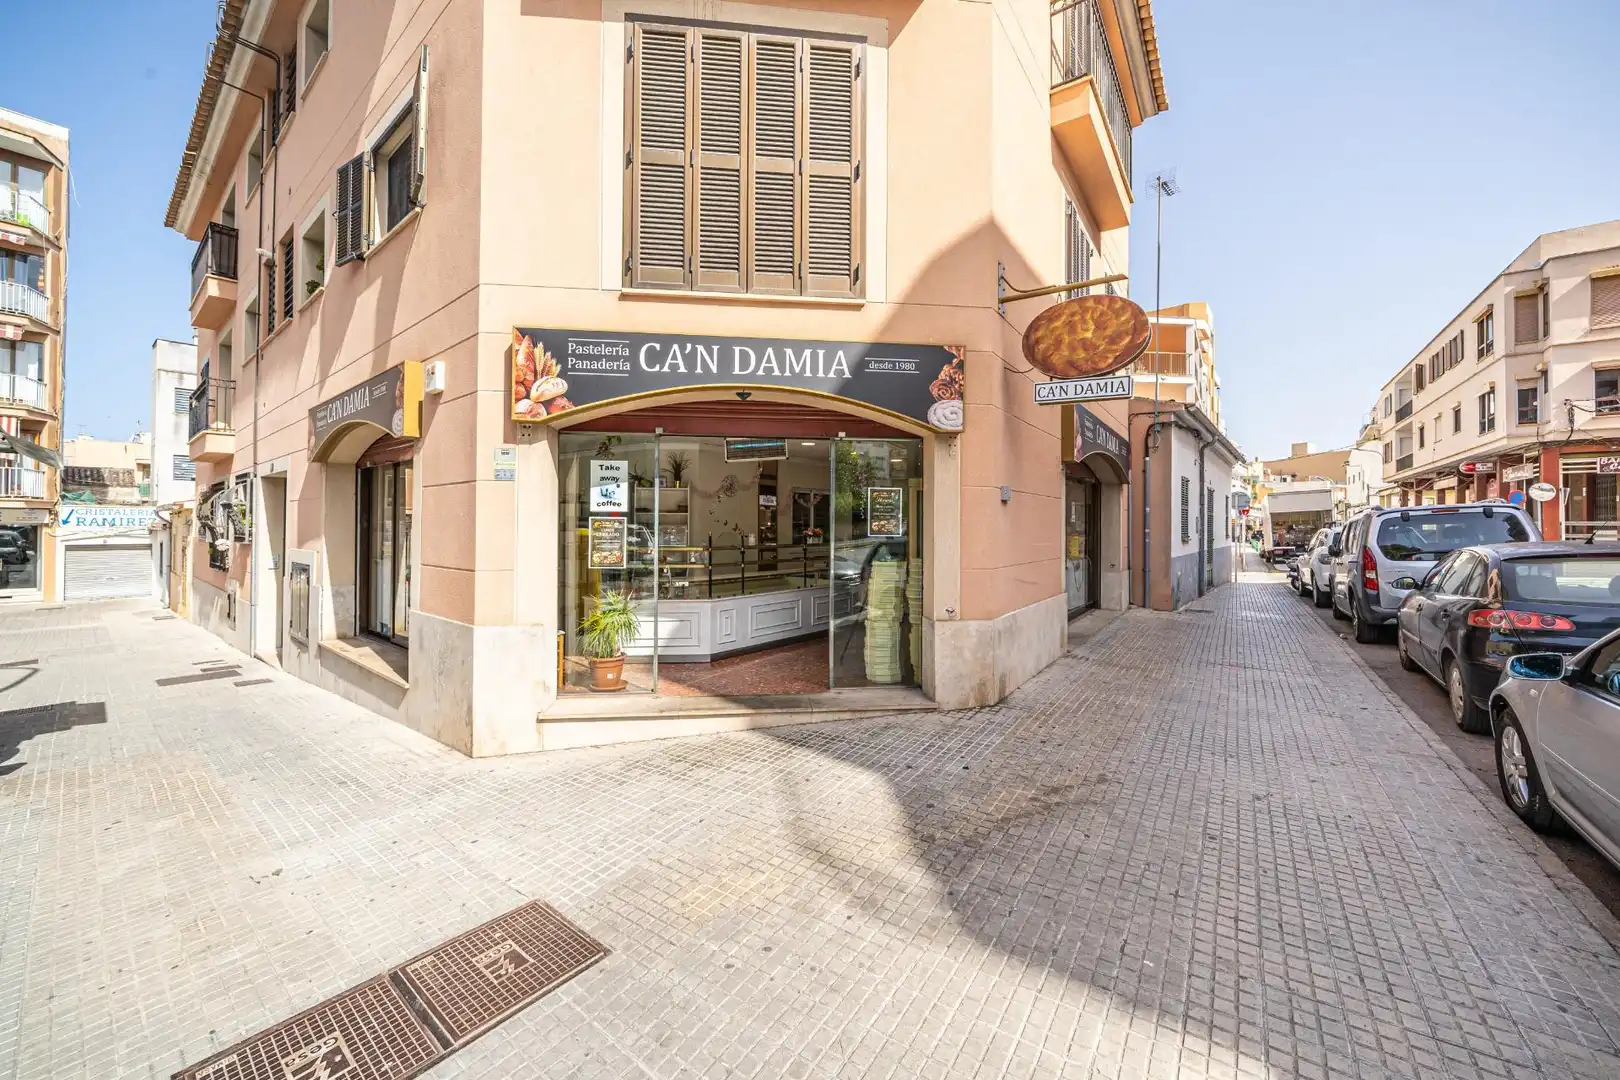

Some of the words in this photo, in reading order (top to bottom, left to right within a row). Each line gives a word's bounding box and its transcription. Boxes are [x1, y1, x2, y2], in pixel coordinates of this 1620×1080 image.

[568, 342, 630, 356] Pastelería
[568, 357, 631, 371] Panadería
[732, 346, 852, 379] DAMIA
[869, 360, 893, 370] desde
[895, 361, 916, 371] 1980
[1074, 380, 1126, 396] DAMIA
[343, 386, 370, 416] DAMIA
[599, 464, 621, 472] Take
[75, 508, 157, 516] CRISTALERIA
[475, 943, 513, 964] Gesa
[285, 1036, 339, 1068] Gesa
